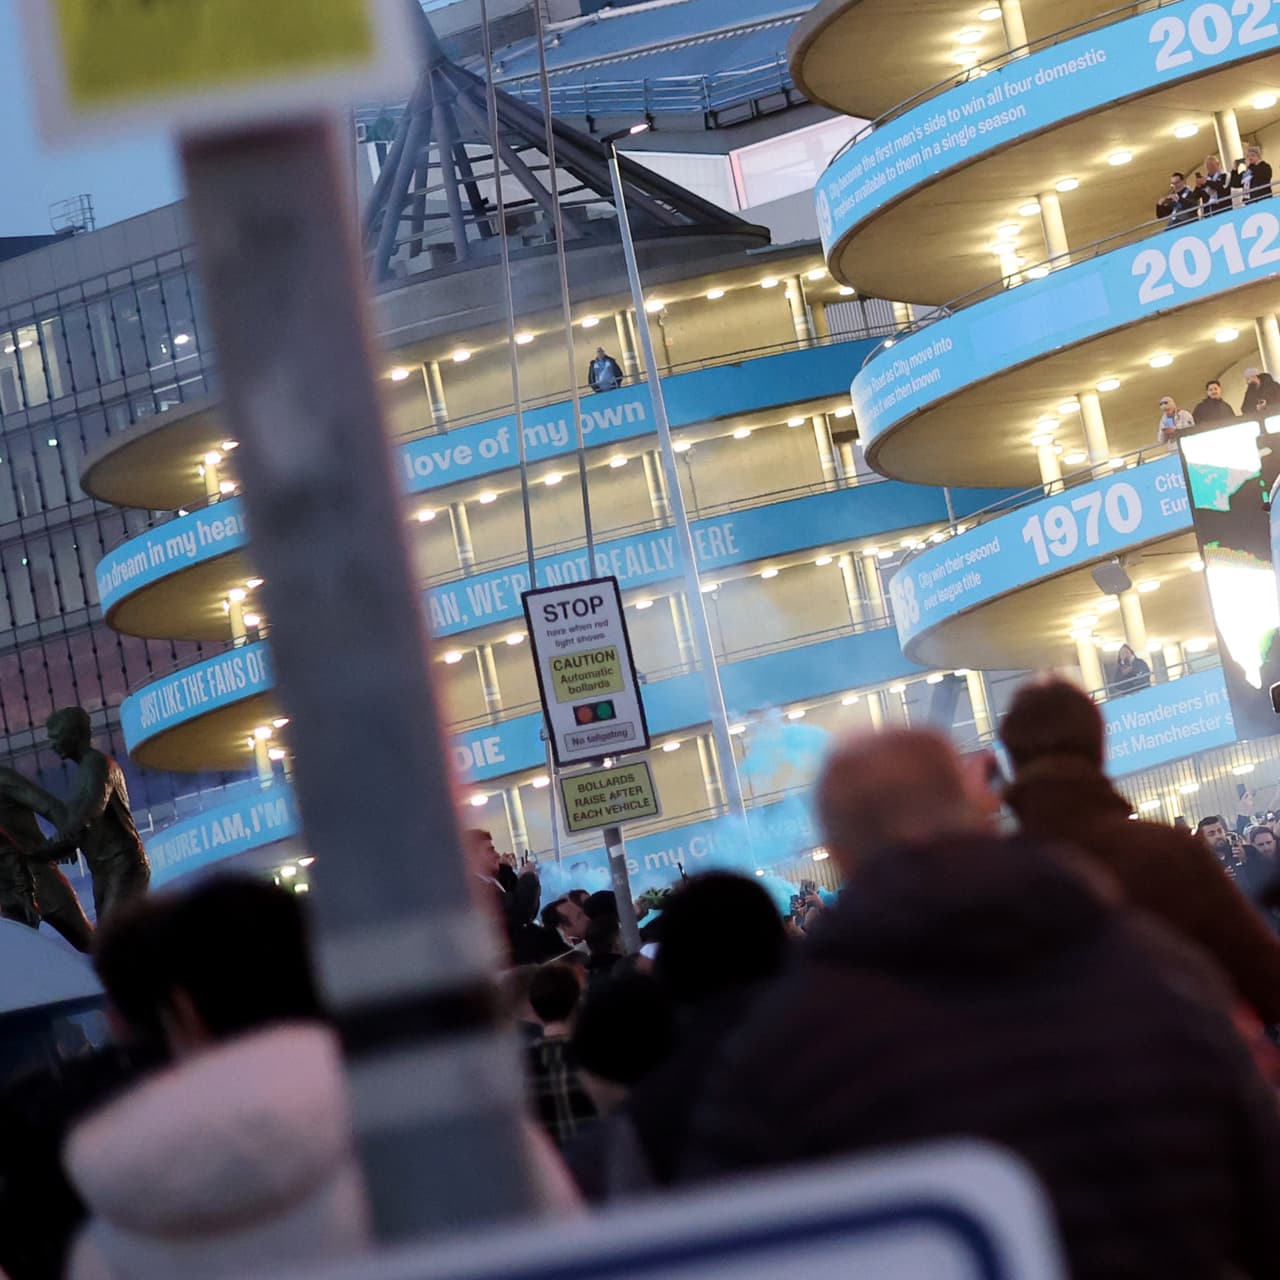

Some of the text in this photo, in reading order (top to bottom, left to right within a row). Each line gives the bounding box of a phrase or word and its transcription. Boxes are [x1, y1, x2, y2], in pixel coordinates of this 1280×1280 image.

[874, 142, 895, 167] first
[894, 125, 924, 153] men's
[923, 113, 948, 136] side
[949, 108, 962, 122] to
[961, 95, 986, 118] win
[987, 84, 1004, 107] all
[1004, 74, 1033, 100] four
[1034, 48, 1107, 86] domestic
[895, 152, 921, 176] them
[921, 145, 934, 161] in
[933, 142, 942, 156] a
[942, 124, 977, 151] single
[977, 103, 1027, 135] season
[893, 358, 910, 376] City
[909, 347, 933, 368] move
[933, 337, 953, 355] into
[895, 382, 912, 401] then
[911, 367, 941, 392] known
[403, 401, 646, 479] love of my own
[1022, 482, 1143, 566] 1970
[111, 551, 148, 588] dream
[147, 540, 166, 568] in
[166, 531, 197, 558] my
[595, 536, 676, 581] REALLY
[688, 522, 740, 561] ERE
[918, 536, 1000, 589] City win their second
[938, 581, 962, 605] league
[962, 571, 981, 591] title
[543, 595, 604, 624] STOP
[555, 632, 606, 649] light shows
[568, 622, 593, 633] when
[553, 649, 616, 672] CAUTION
[560, 666, 614, 685] Automatic
[159, 681, 185, 718] LIKE
[183, 669, 208, 707] THE
[207, 656, 246, 699] FANS
[246, 648, 267, 685] OF
[567, 679, 611, 696] bollards
[1122, 696, 1203, 729] Wanderers
[1204, 688, 1220, 706] in
[572, 736, 586, 747] No
[1131, 717, 1222, 753] Manchester
[575, 785, 644, 808] RAISE AFTER
[577, 773, 636, 794] BOLLARDS
[201, 825, 210, 850] I
[211, 813, 252, 848] AM,
[251, 798, 290, 833] I'M
[573, 798, 651, 823] EACH VEHICLE
[643, 843, 686, 869] my
